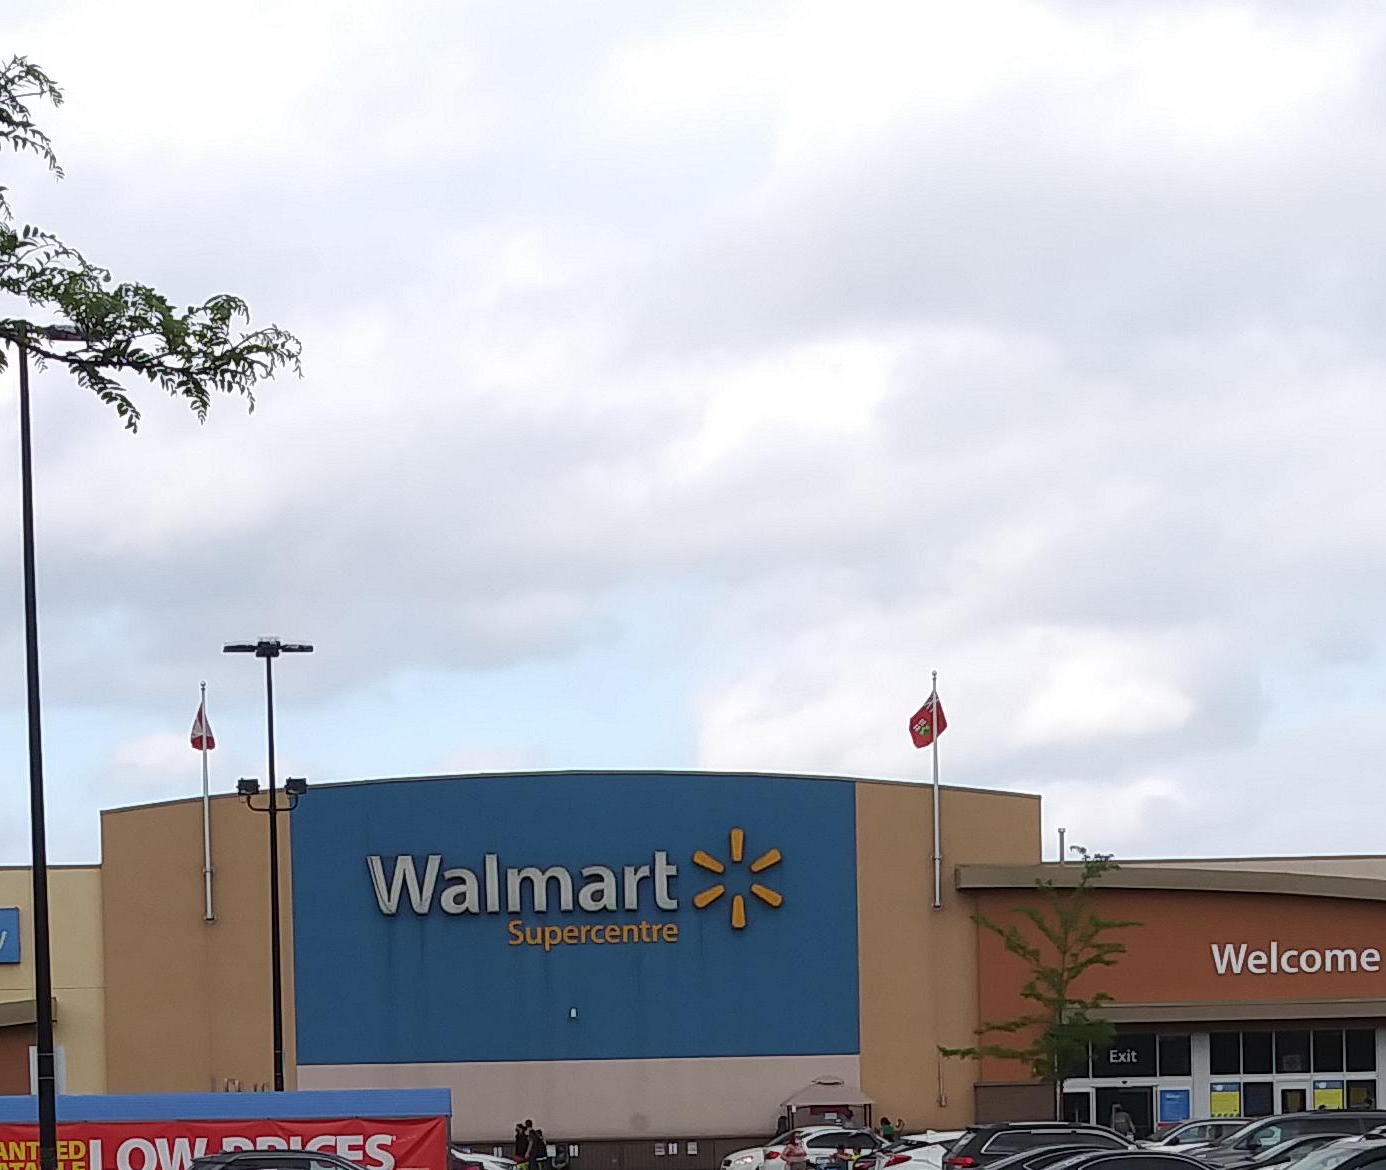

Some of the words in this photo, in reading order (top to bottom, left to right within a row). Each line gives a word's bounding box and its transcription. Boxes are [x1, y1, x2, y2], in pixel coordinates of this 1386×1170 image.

[366, 850, 679, 916] Walmart
[507, 919, 679, 952] Supercentre
[1210, 940, 1382, 975] Welcome
[1109, 1048, 1138, 1063] Exit
